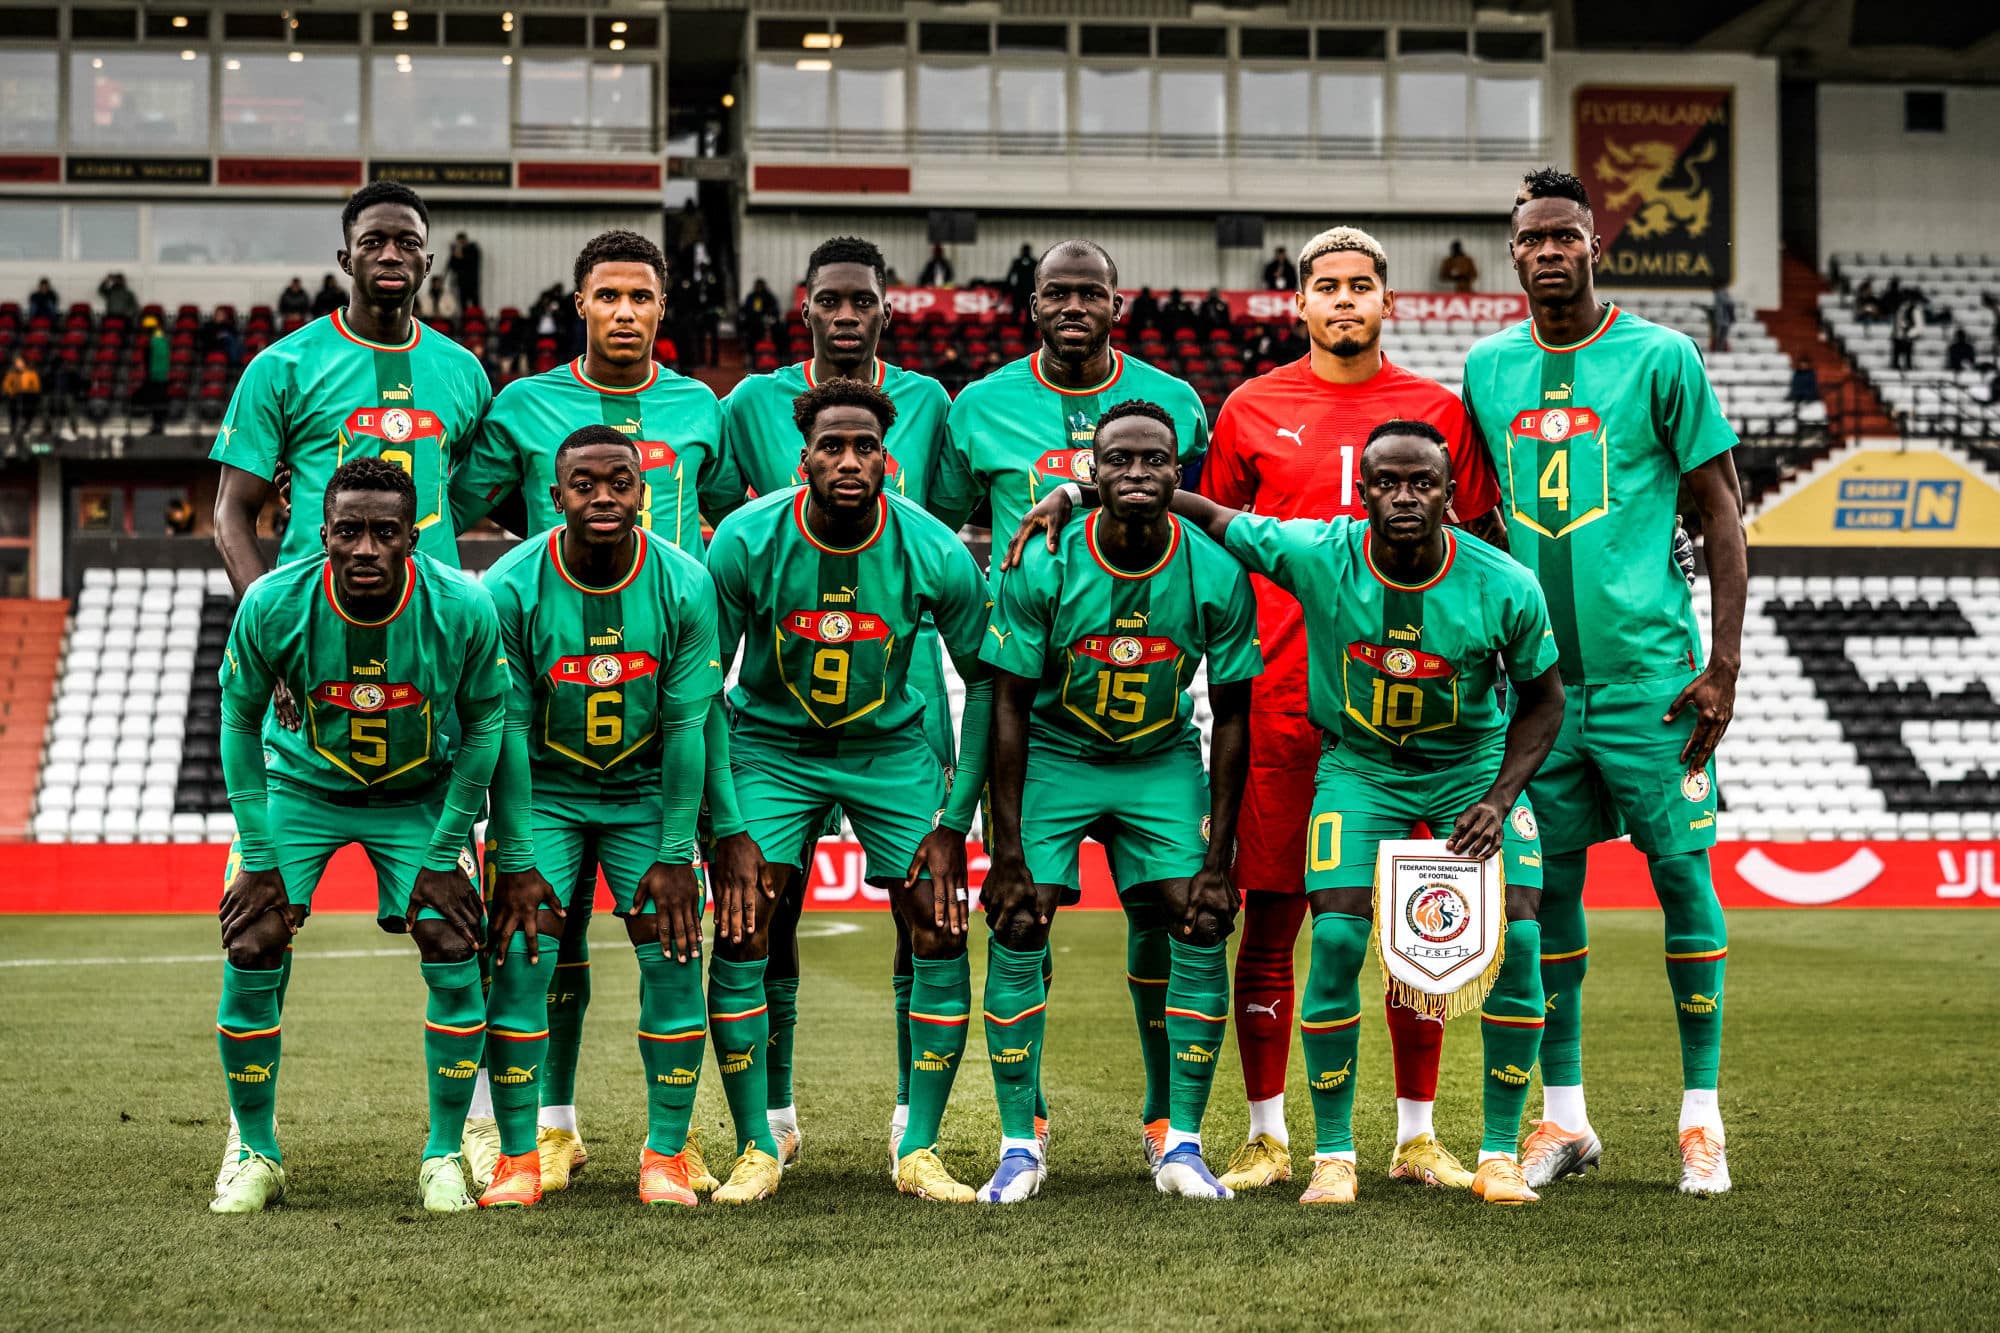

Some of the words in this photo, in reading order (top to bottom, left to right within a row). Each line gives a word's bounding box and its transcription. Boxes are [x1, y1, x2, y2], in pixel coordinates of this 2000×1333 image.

[1581, 103, 1726, 124] FLYERALARM
[1395, 297, 1520, 320] SHARP
[383, 390, 409, 400] PUMA
[1545, 390, 1569, 400] PUMA
[1072, 432, 1095, 441] PUM
[1340, 445, 1354, 506] 1
[1539, 449, 1570, 511] 4
[823, 593, 851, 603] PUMA
[1116, 618, 1143, 628] PUMA
[590, 635, 618, 646] PUMA
[1388, 629, 1416, 641] PUMA
[352, 665, 381, 675] PUMA
[811, 648, 850, 705] 9
[1095, 670, 1150, 723] 15
[1371, 677, 1424, 728] 10
[586, 690, 623, 746] 6
[350, 717, 387, 767] 5
[1690, 817, 1713, 831] PUMA
[1680, 1002, 1713, 1013] PUMA
[1149, 1020, 1165, 1029] PU
[991, 1053, 1024, 1064] PUMA
[1176, 1052, 1209, 1063] PUMA
[720, 1060, 748, 1074] PUMA
[914, 1060, 944, 1071] PUMA
[228, 1071, 266, 1083] PUMA
[438, 1066, 475, 1079] PUMA
[493, 1073, 528, 1084] PUMA
[1491, 1068, 1527, 1085] PUMA
[657, 1073, 693, 1085] PUMA
[1311, 1074, 1345, 1090] PUMA
